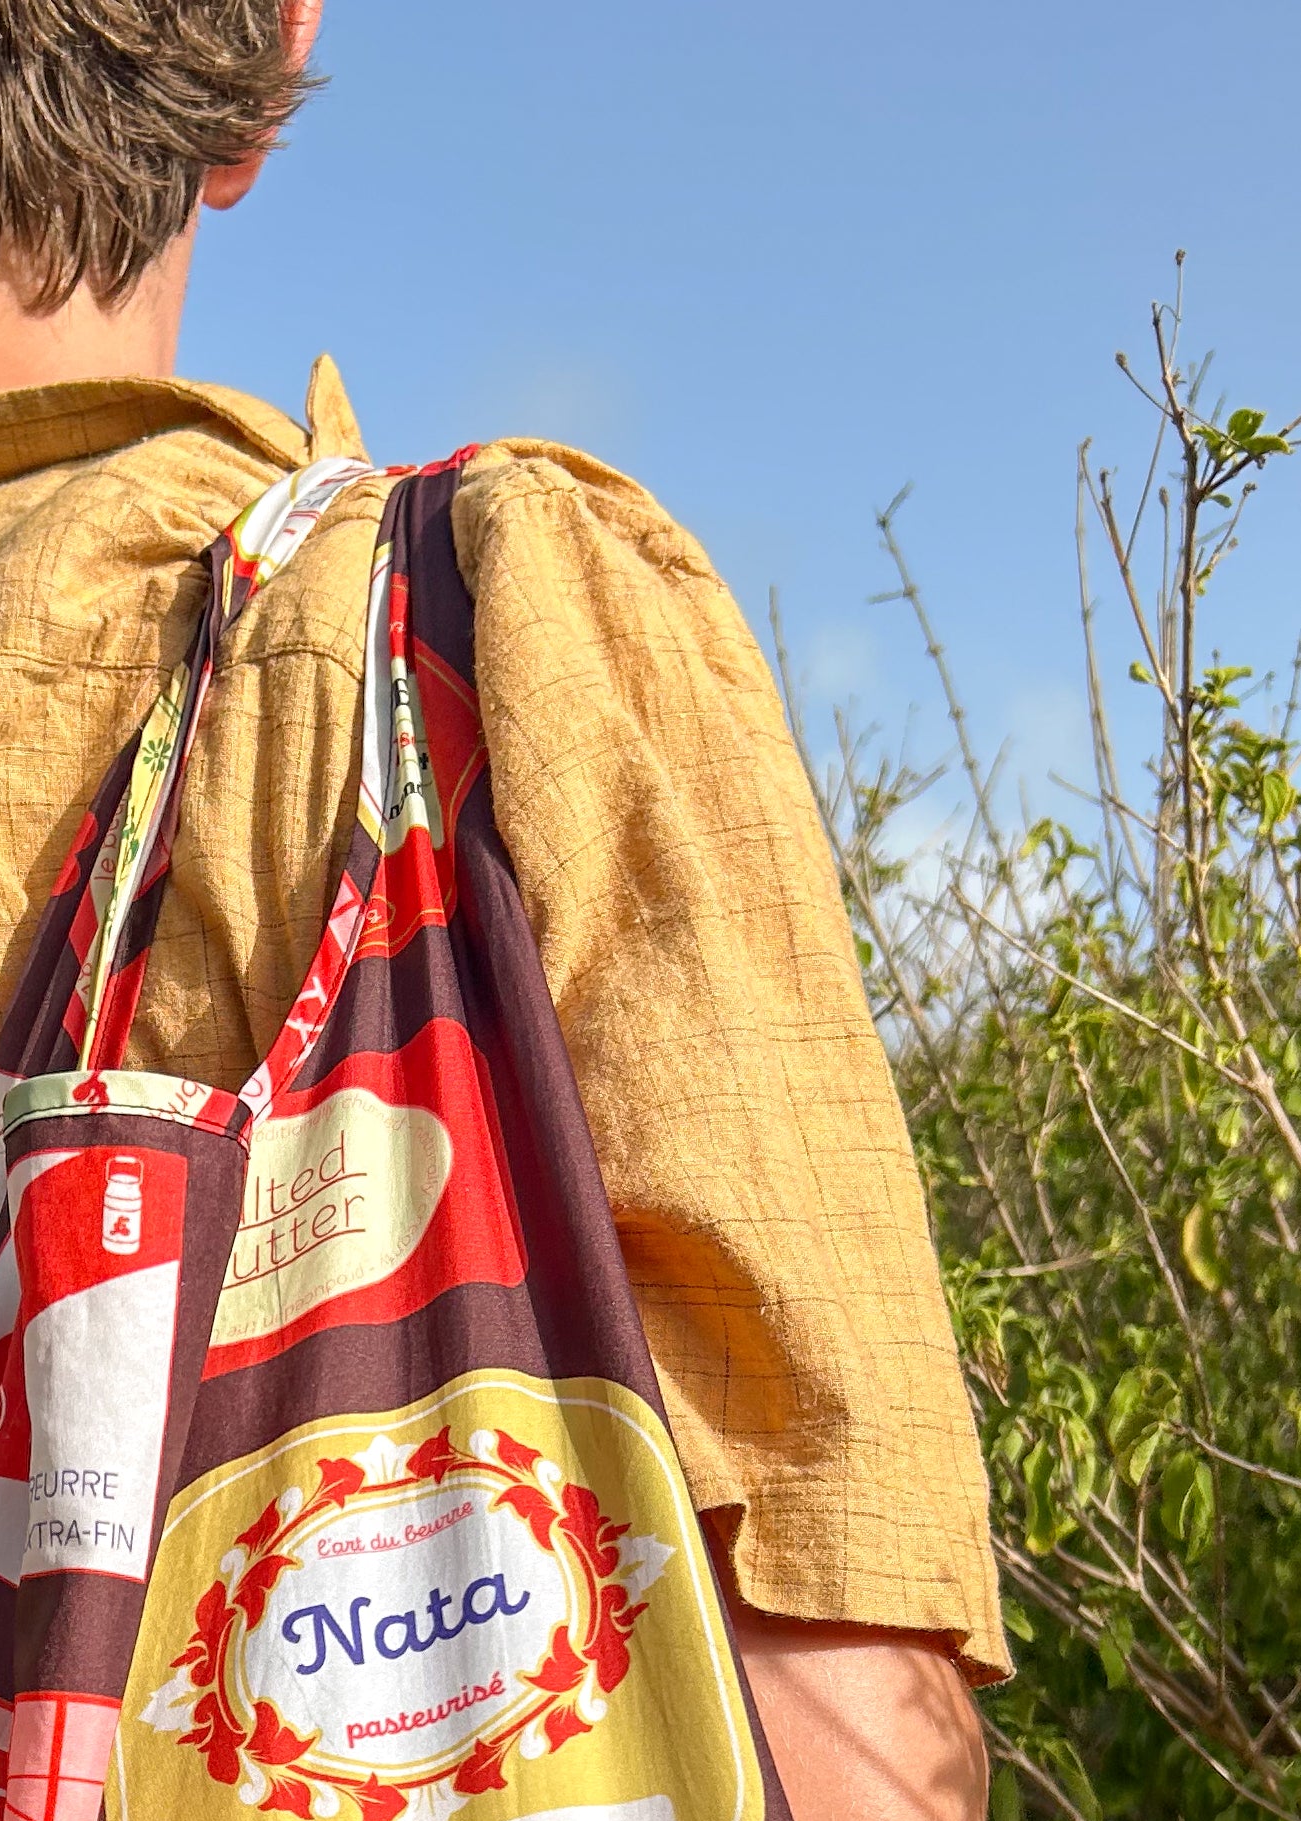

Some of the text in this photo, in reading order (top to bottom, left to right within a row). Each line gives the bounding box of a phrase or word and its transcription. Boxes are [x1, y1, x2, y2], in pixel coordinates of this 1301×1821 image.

[243, 1130, 346, 1223] lted
[233, 1195, 365, 1280] utter
[26, 1519, 135, 1552] XTRA-FIN
[317, 1501, 474, 1556] l'art du beurre
[281, 1573, 531, 1676] Nata
[347, 1671, 506, 1748] pasteurisé
